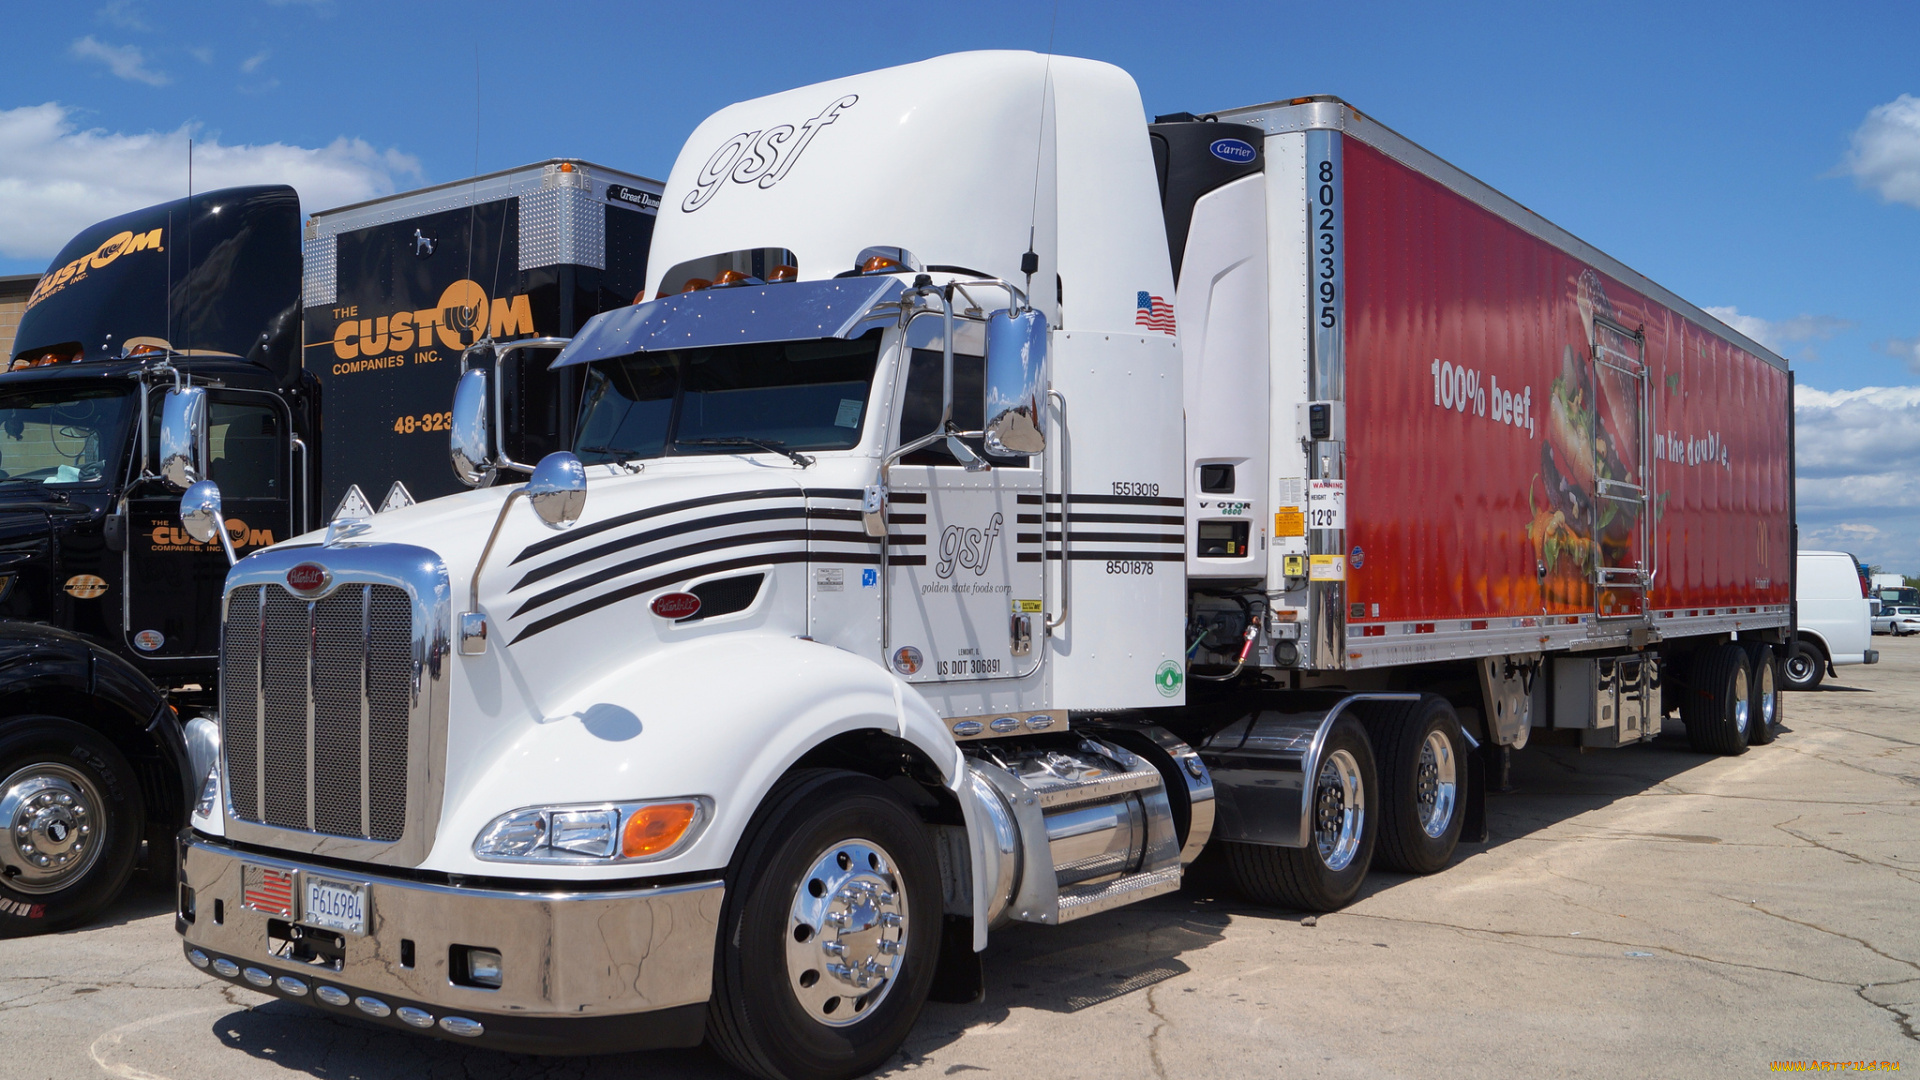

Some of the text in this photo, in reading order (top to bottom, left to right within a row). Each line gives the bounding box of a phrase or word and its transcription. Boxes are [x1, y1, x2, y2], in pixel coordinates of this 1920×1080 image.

[681, 94, 859, 213] gsf
[1216, 143, 1252, 157] Carrier
[620, 187, 660, 208] Great Dane
[1318, 160, 1336, 329] 8023395
[332, 305, 358, 319] THE
[332, 350, 443, 375] COMPANIES INC.
[1431, 358, 1535, 440] 100% beef,
[394, 411, 452, 435] 48-323
[1667, 430, 1685, 465] the
[1687, 429, 1730, 472] double.
[1111, 481, 1160, 497] 15513019
[1311, 508, 1337, 526] 12'8"
[151, 545, 203, 553] COMPANIES,
[935, 511, 1004, 580] gsf
[1106, 560, 1154, 575] 8501878
[1335, 562, 1343, 573] 6
[921, 581, 1014, 597] golden state foods corp.
[656, 598, 697, 614] Peterbilt
[957, 648, 975, 656] LEMONT,
[937, 659, 1001, 676] US DOT 306891
[312, 887, 361, 921] P616984
